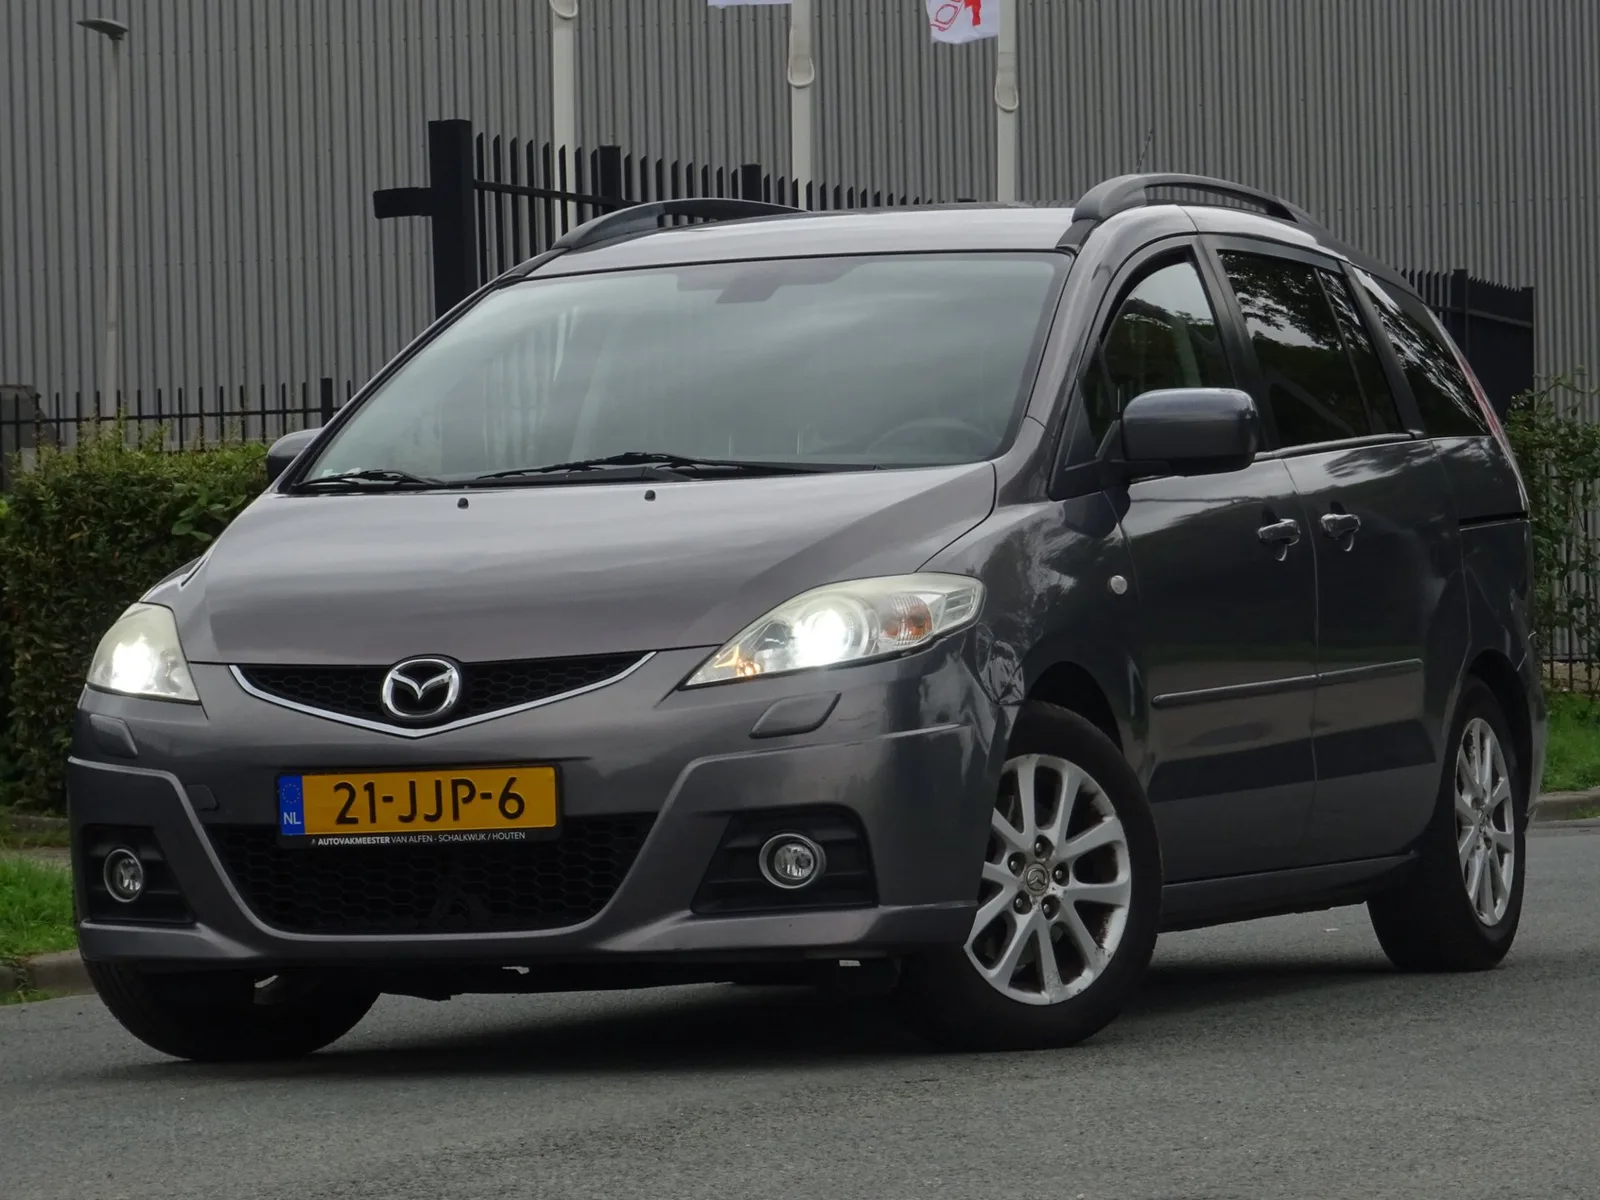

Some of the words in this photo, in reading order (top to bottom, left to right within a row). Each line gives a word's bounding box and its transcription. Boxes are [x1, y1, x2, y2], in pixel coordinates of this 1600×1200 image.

[333, 776, 525, 825] 21-JJP-6
[283, 812, 301, 825] NL
[317, 836, 390, 846] AUTOVAKMEESTER
[391, 836, 407, 844] VAN
[408, 834, 433, 843] ALFEN
[492, 831, 526, 840] HOUTEN
